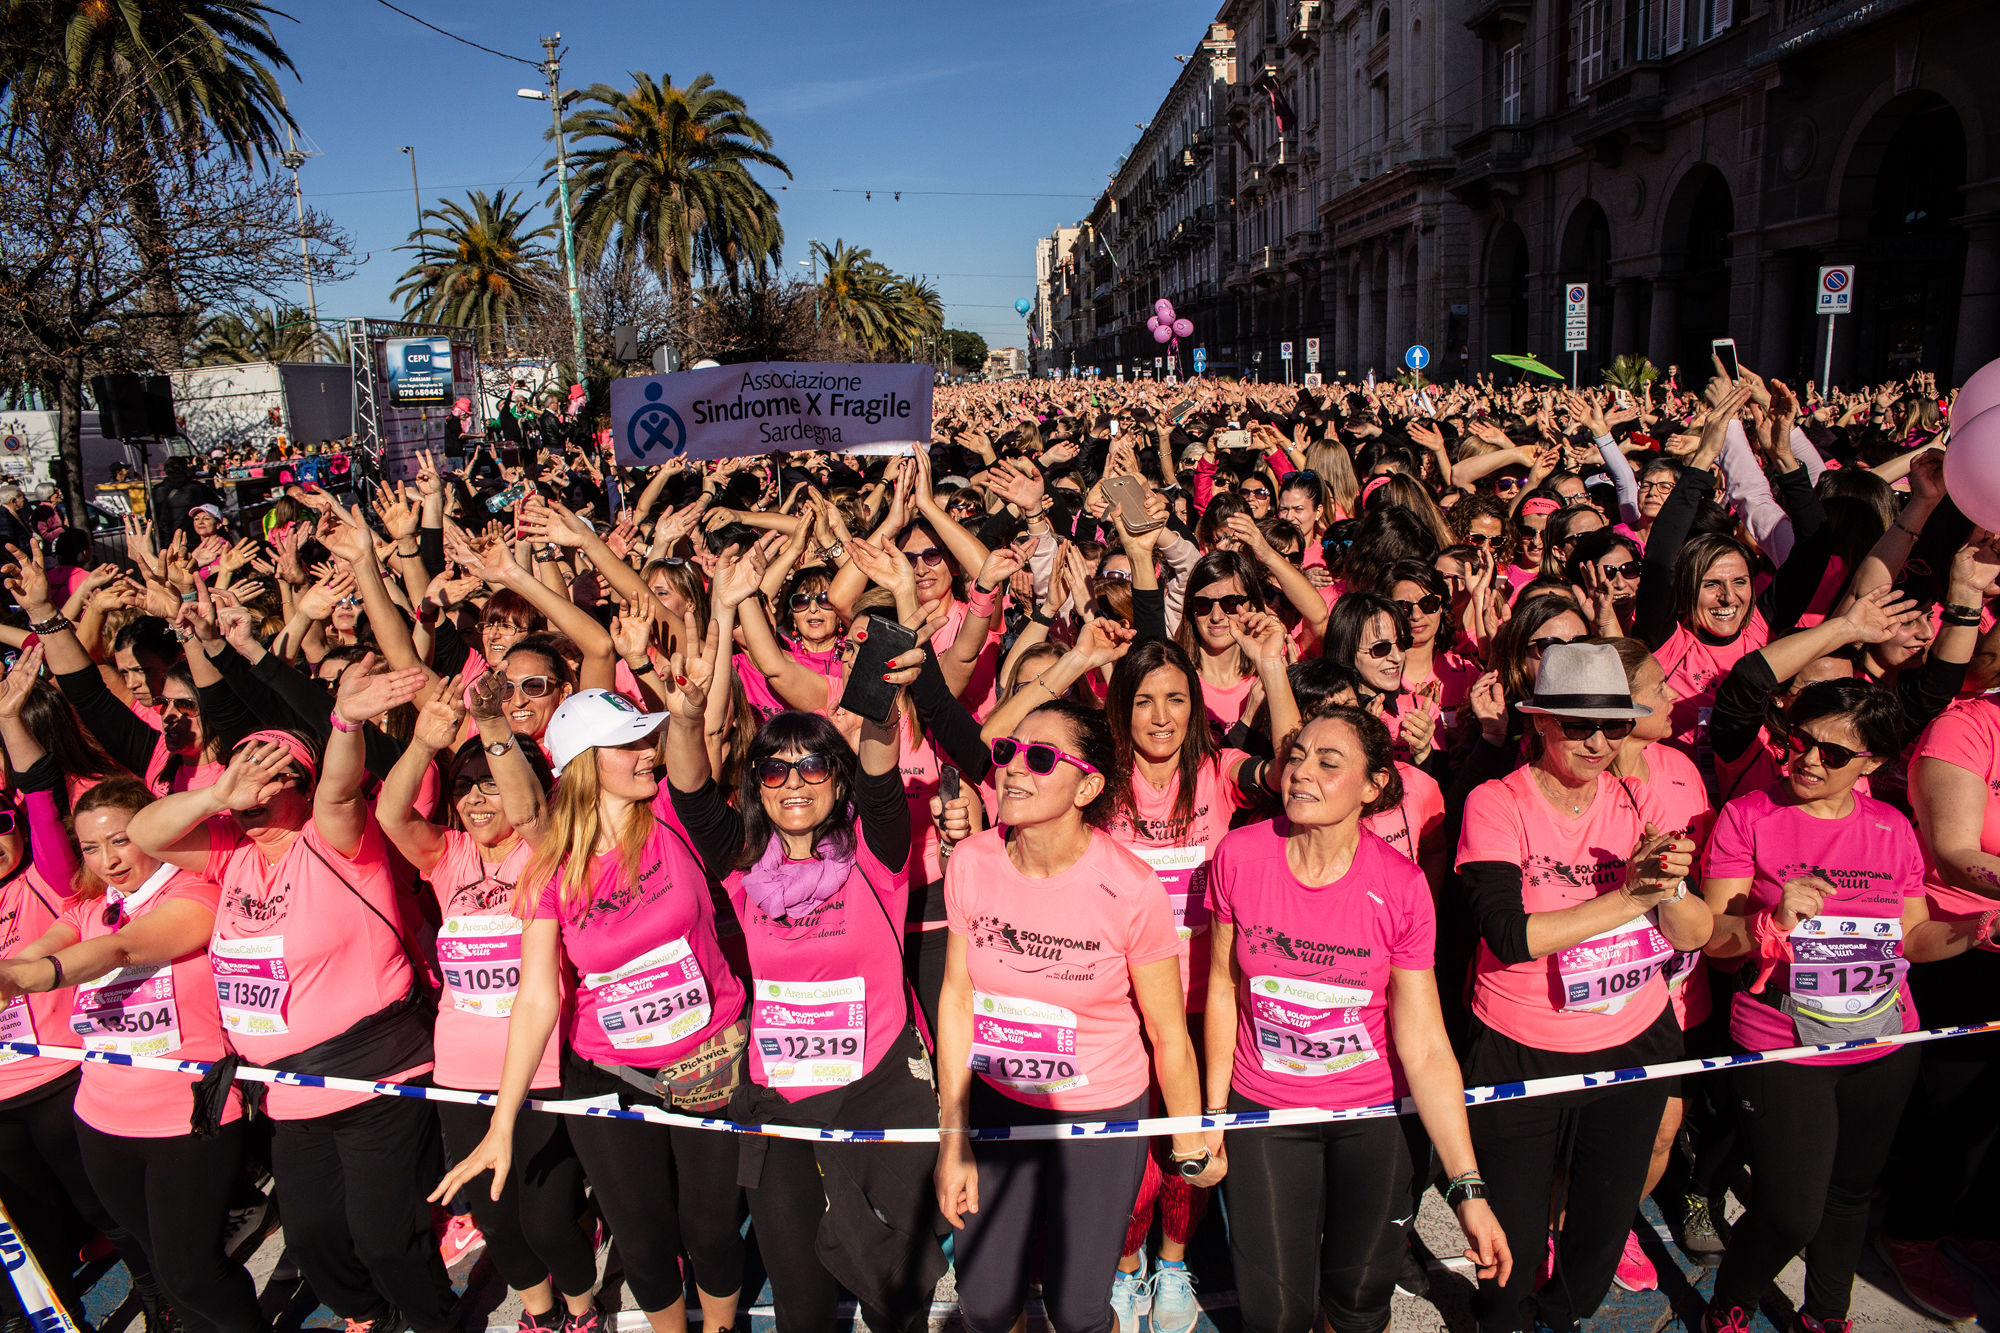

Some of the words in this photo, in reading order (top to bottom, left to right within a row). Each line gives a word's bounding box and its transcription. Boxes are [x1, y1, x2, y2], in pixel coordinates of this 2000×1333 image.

[408, 355, 429, 363] CEPU
[740, 371, 862, 392] Associazione
[415, 388, 444, 396] 650443
[692, 394, 801, 424] Sindrome
[806, 392, 821, 417] X
[830, 392, 911, 424] Fragile
[759, 420, 843, 444] Sardegna
[1156, 827, 1186, 840] run
[1582, 871, 1618, 887] run
[1829, 869, 1894, 880] SOLOWOMEN
[1838, 878, 1871, 889] run
[253, 906, 276, 920] run
[818, 929, 846, 938] donne
[1020, 931, 1101, 951] SOLOWOMEN
[1648, 930, 1660, 952] OPEN
[1653, 929, 1669, 950] 2019
[467, 942, 508, 950] SOLOWOMEN
[471, 948, 491, 957] run
[1025, 944, 1063, 961] run
[1294, 939, 1371, 957] SOLOWOMEN
[1595, 939, 1639, 954] SOLOWOMEN
[1834, 949, 1855, 958] run
[1299, 950, 1336, 966] run
[1601, 949, 1622, 961] run
[269, 960, 279, 979] OPEN
[276, 960, 286, 979] 2019
[680, 961, 691, 979] OPEN
[686, 957, 700, 977] 2019
[628, 971, 669, 987] SOLOWOMEN
[1060, 970, 1095, 981] donne
[1334, 974, 1367, 987] donne
[1832, 962, 1896, 993] 125
[162, 978, 171, 998] 2019
[634, 981, 655, 992] run
[234, 983, 280, 1008] 13501
[629, 988, 702, 1026] 12318
[791, 1010, 834, 1018] SOLOWOMEN
[848, 1004, 856, 1026] OPEN
[856, 1003, 864, 1026] 2019
[97, 1008, 172, 1032] 13504
[795, 1017, 815, 1025] run
[1286, 1010, 1331, 1021] SOLOWOMEN
[1290, 1018, 1312, 1028] run
[1, 1022, 22, 1032] siamo
[1003, 1027, 1042, 1039] SOLOWOMEN
[784, 1036, 858, 1059] 12319
[1007, 1034, 1025, 1045] run
[1057, 1028, 1065, 1052] OPEN
[1065, 1029, 1074, 1053] 2019
[1285, 1034, 1363, 1058] 12371
[680, 1047, 729, 1072] Pickwick
[996, 1057, 1075, 1079] 12370
[673, 1089, 724, 1104] Pickwick
